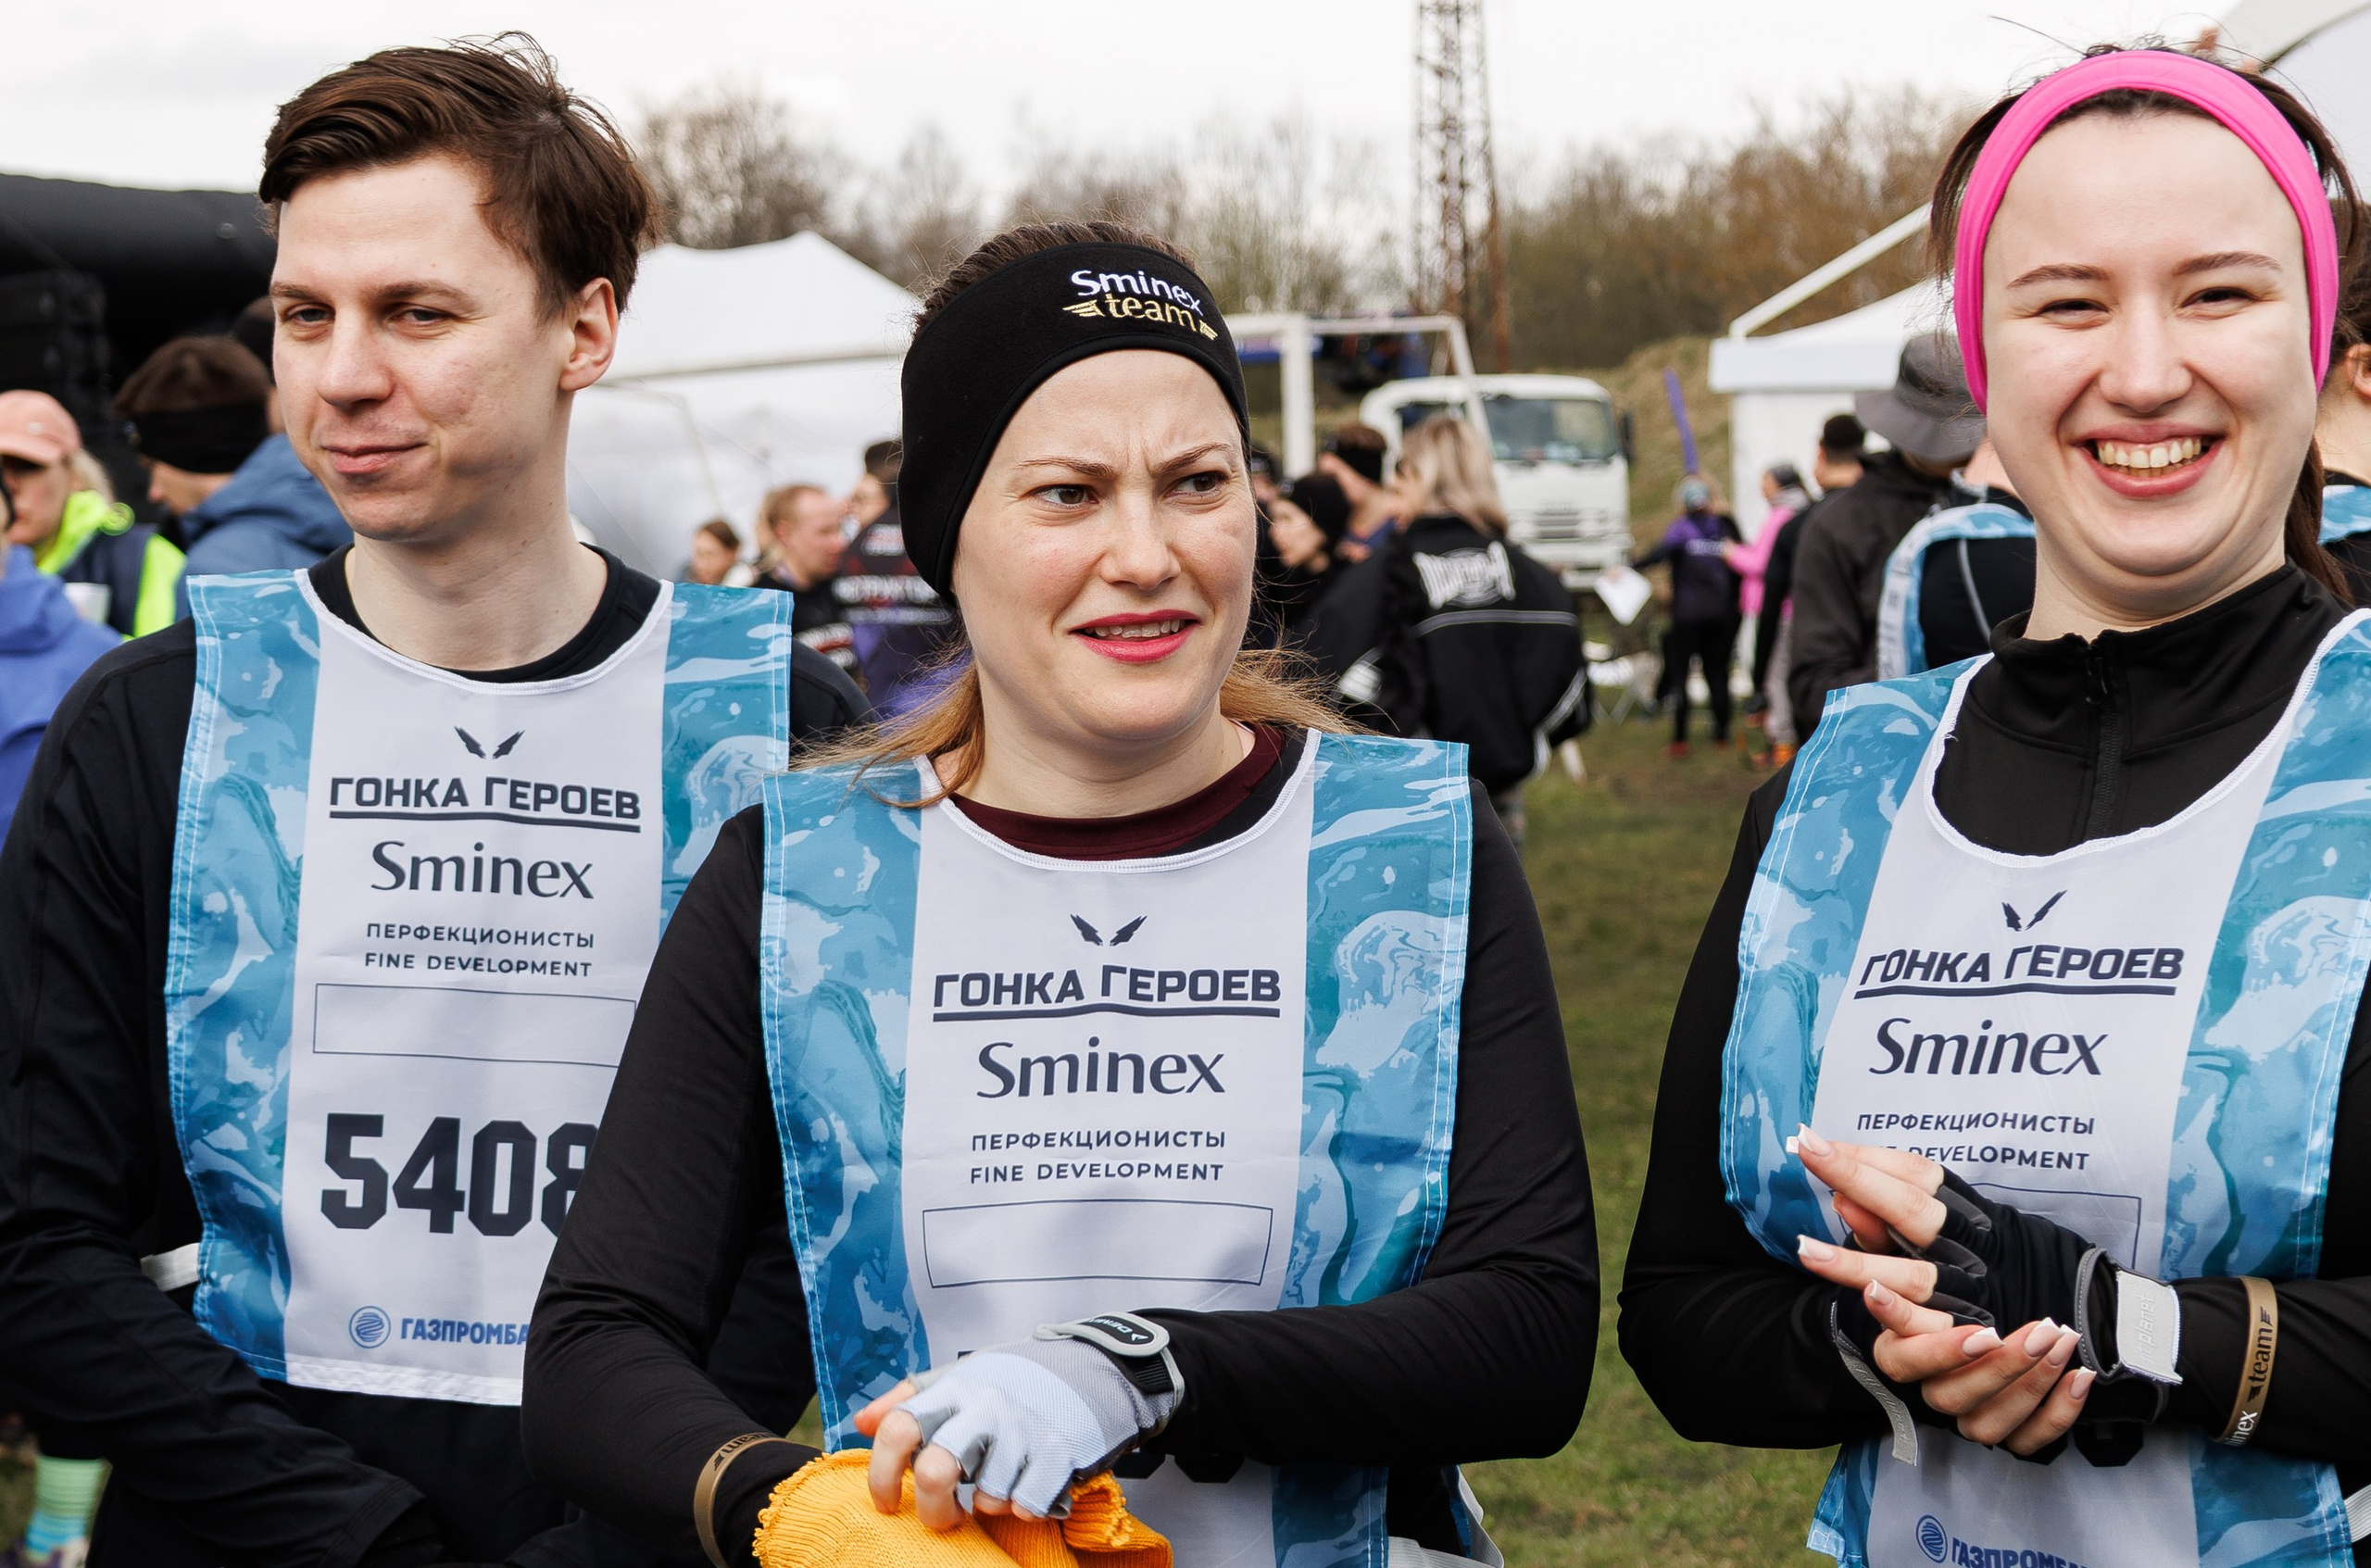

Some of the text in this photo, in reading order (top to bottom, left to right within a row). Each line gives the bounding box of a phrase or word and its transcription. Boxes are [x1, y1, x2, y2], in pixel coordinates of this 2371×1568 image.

[1071, 270, 1204, 317] Sminex
[1104, 294, 1198, 333] team
[330, 776, 642, 820] ГОНКА ГЕРОЕВ
[370, 840, 595, 899] Sminex
[367, 922, 595, 948] ПЕРФЕКЦИОНИСТЫ
[364, 952, 593, 977] FINE DEVELOPMENT
[933, 964, 1282, 1008] ГОНКА ГЕРОЕВ
[1859, 944, 2185, 986] ГОНКА ГЕРОЕВ
[976, 1035, 1226, 1099] Sminex
[1867, 1016, 2110, 1076] Sminex
[971, 1130, 1226, 1152] ПЕРФЕКЦИОНИСТЫ
[1857, 1111, 2096, 1135] ПЕРФЕКЦИОНИСТЫ
[970, 1162, 1224, 1185] FINE DEVELOPMENT
[2134, 1292, 2158, 1348] planet
[2248, 1328, 2274, 1385] team
